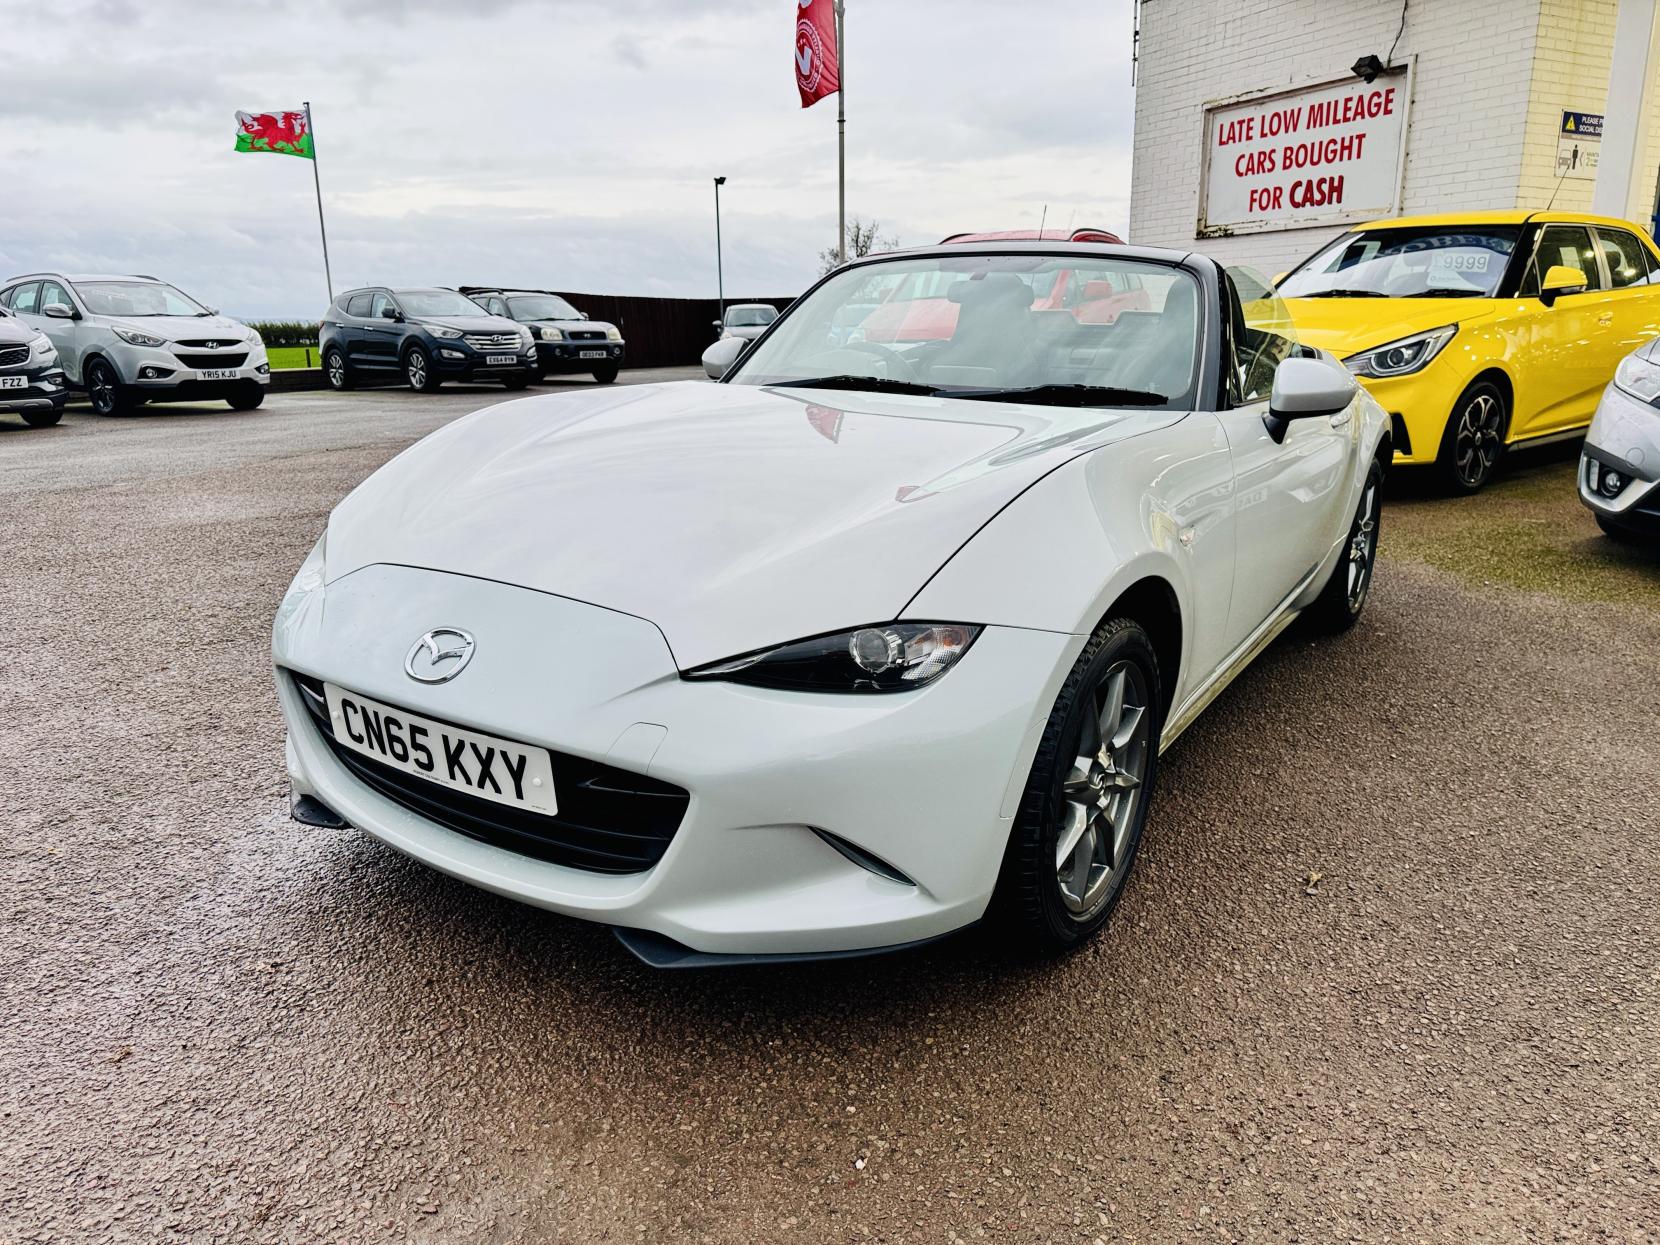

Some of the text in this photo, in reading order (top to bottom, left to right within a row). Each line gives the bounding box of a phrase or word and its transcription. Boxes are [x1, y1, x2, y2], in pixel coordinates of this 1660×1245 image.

[1218, 87, 1395, 146] LATE LOW MILEAGE
[1579, 124, 1595, 133] SOCIAL
[1582, 117, 1599, 125] PLEASE
[1234, 133, 1367, 177] CARS BOUGHT
[1249, 174, 1344, 212] FOR CASH
[2, 377, 22, 388] FZZ
[202, 370, 236, 379] YR15 KJU
[341, 698, 527, 800] CN65 KXY
